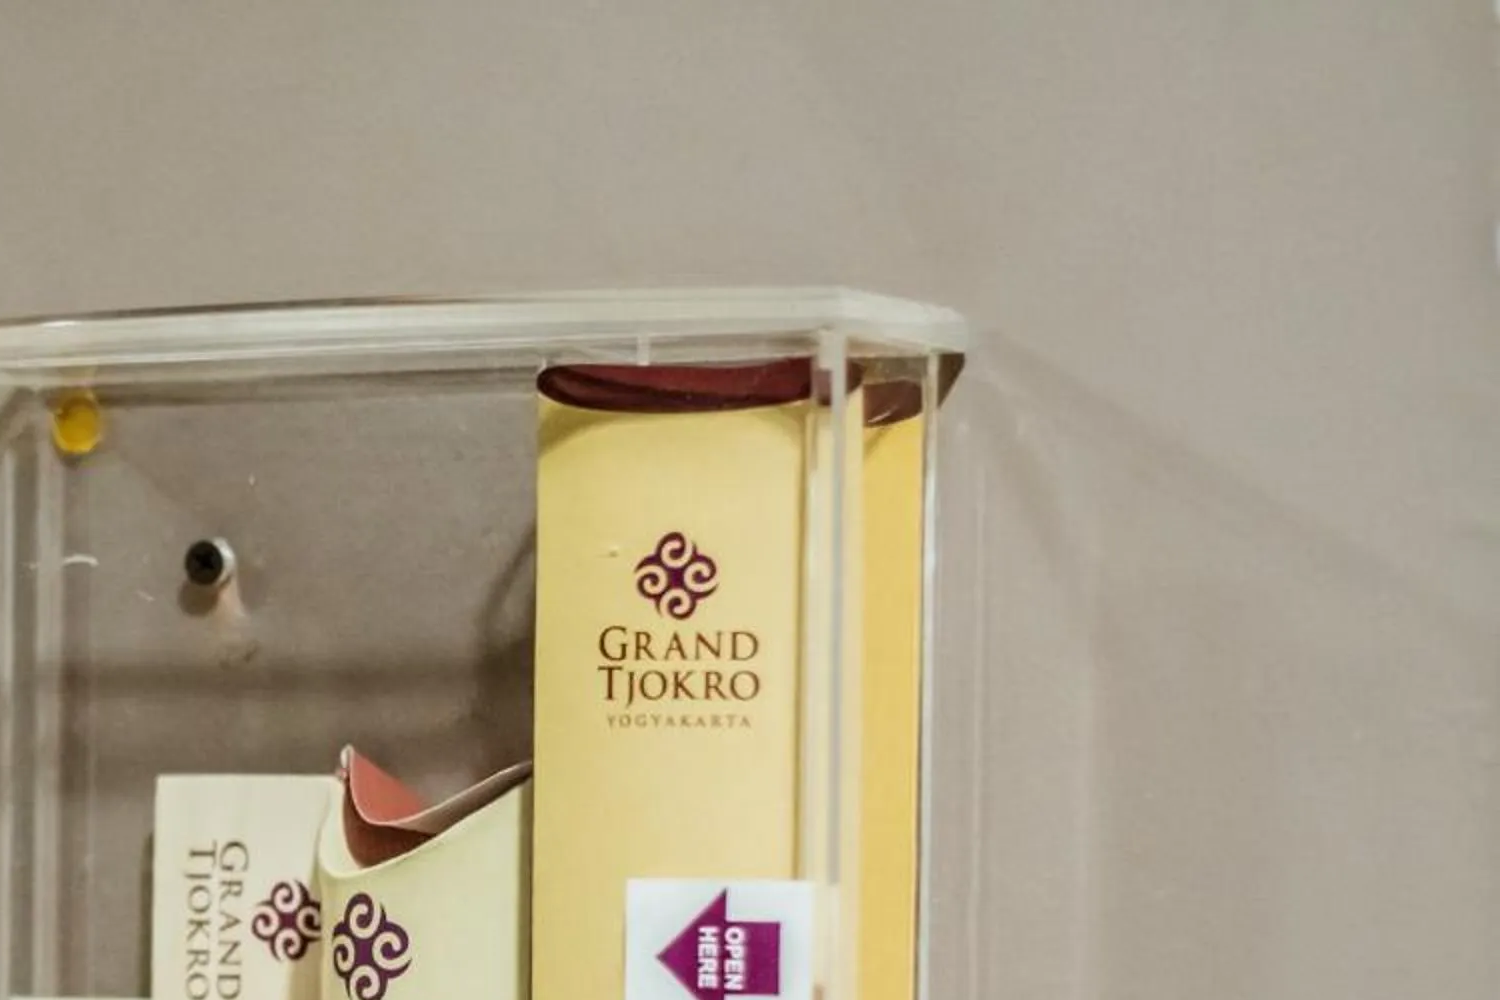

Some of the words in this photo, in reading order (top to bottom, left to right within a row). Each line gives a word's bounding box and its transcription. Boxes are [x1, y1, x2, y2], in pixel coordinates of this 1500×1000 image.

[598, 625, 760, 662] GRAND
[597, 665, 761, 708] TJOKRO
[606, 713, 752, 729] YOGYAKARTA
[216, 840, 250, 1000] GRAND
[698, 926, 720, 989] HERE
[724, 926, 746, 991] OPEN
